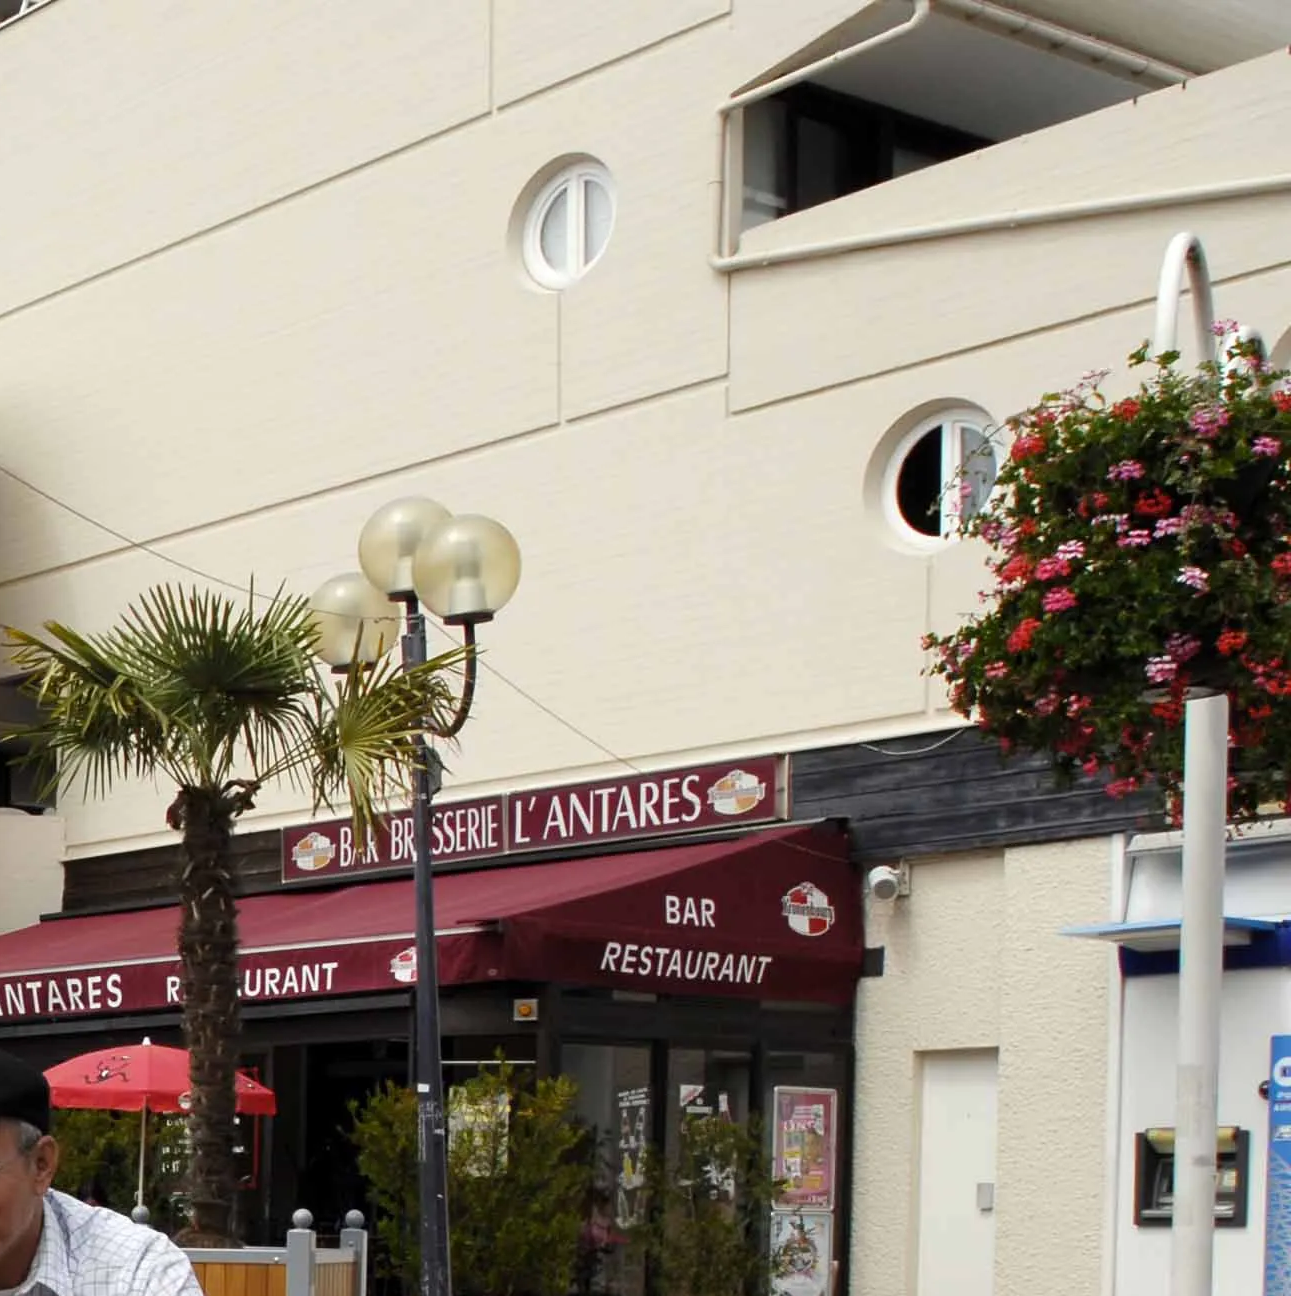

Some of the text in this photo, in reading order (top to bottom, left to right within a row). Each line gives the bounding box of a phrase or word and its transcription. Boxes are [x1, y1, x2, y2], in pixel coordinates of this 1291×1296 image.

[390, 804, 499, 862] BRSSERIE
[665, 895, 716, 928] BAR
[166, 961, 339, 1003] RURANT
[600, 941, 773, 984] RESTAURANT
